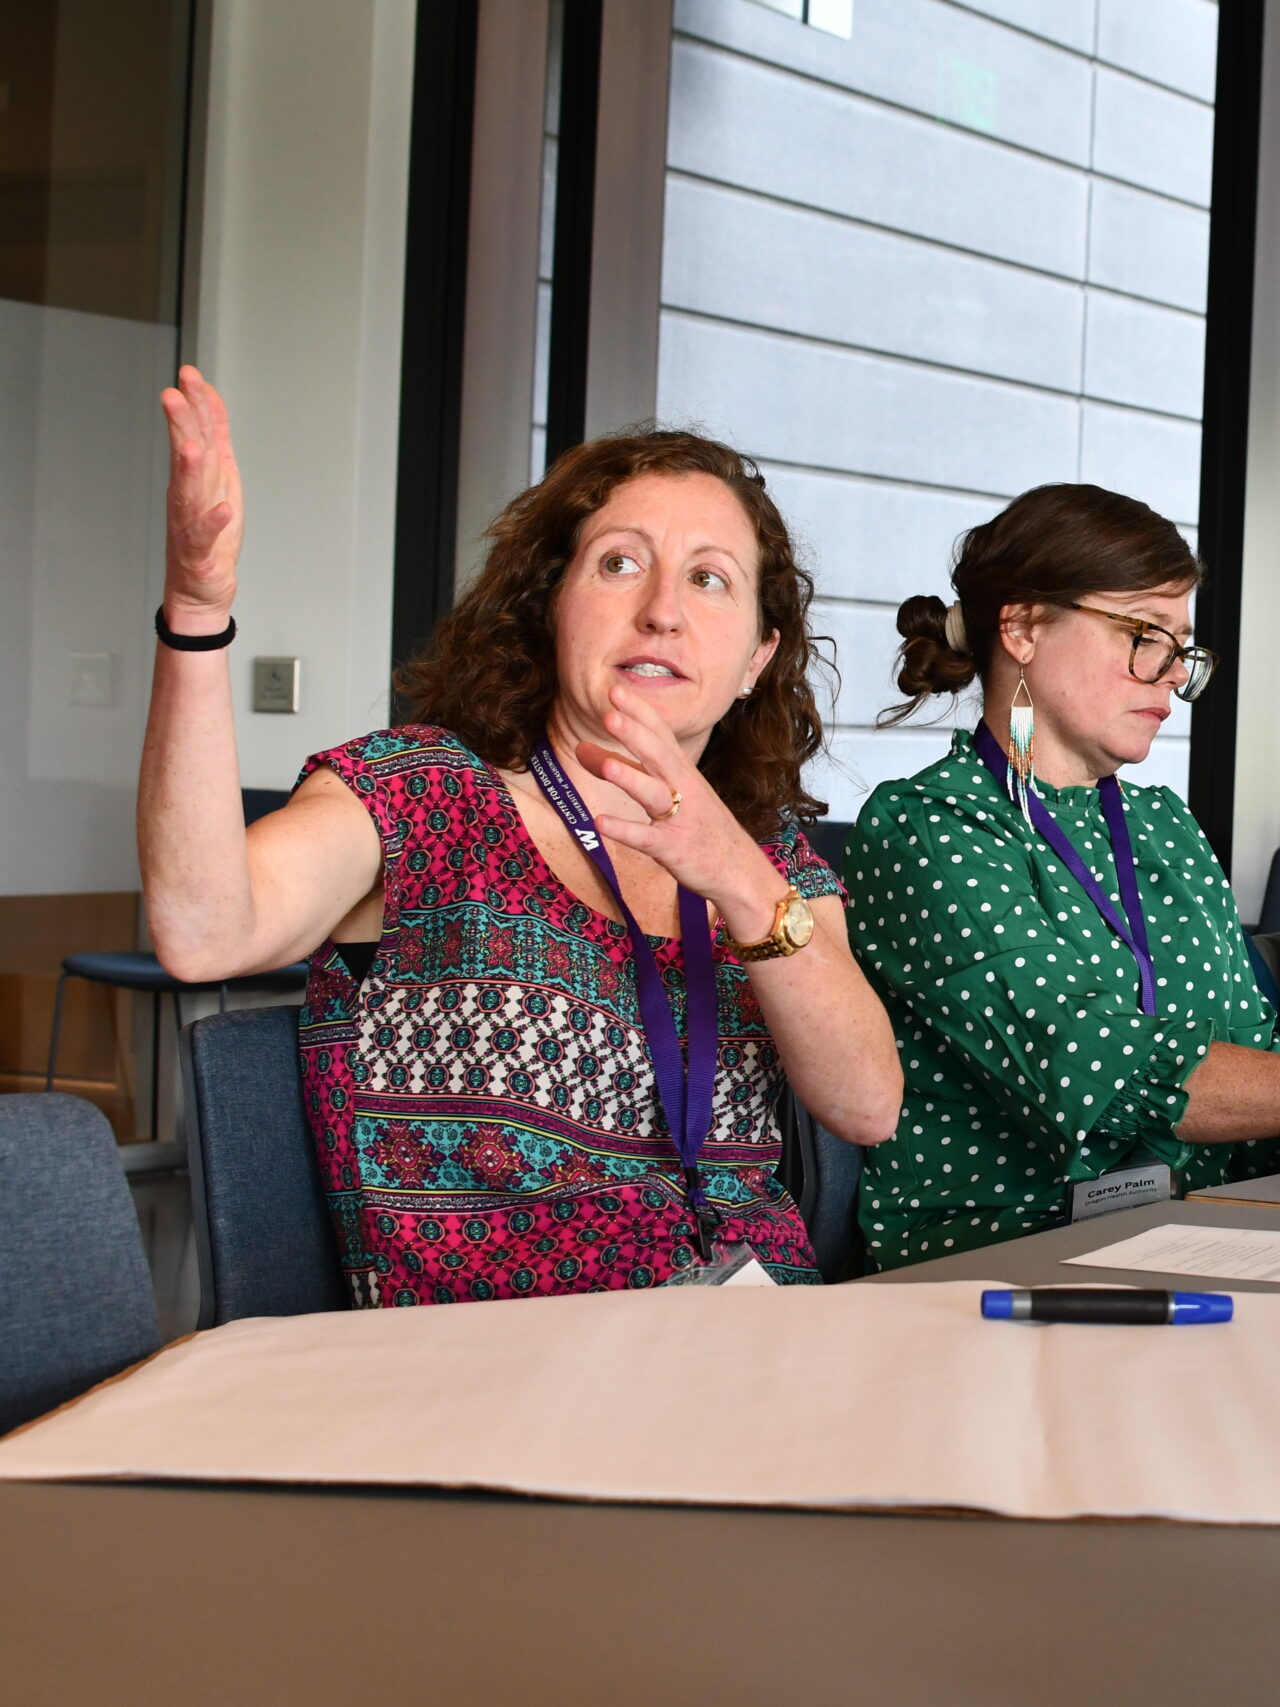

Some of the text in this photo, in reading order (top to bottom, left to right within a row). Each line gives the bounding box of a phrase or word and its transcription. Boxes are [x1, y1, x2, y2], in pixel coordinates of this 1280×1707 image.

[542, 749, 564, 785] WASHINGTON
[530, 755, 578, 825] CENTER FOR DISASTER
[565, 791, 590, 822] UNIVERSITY
[574, 828, 600, 852] W
[1088, 1179, 1154, 1199] Carey Palm
